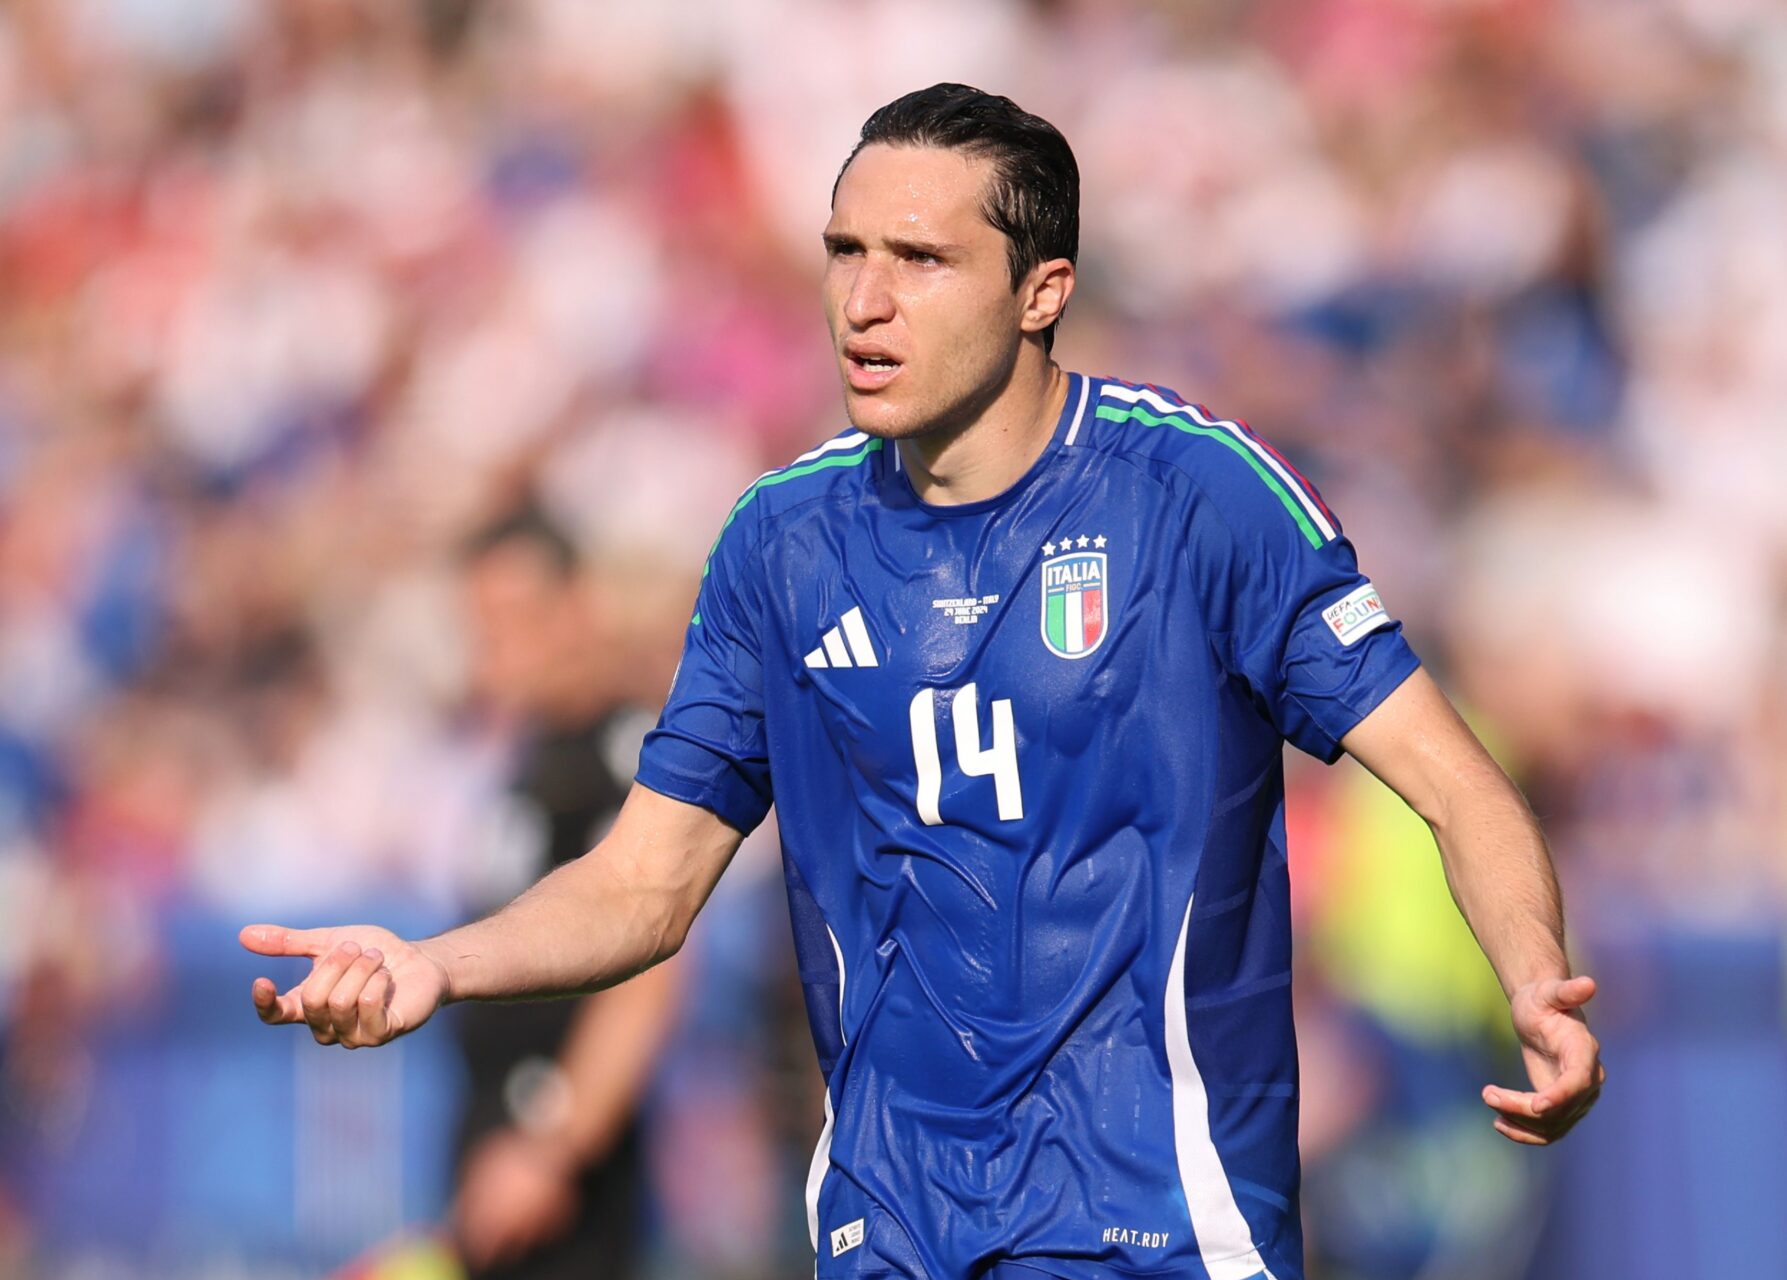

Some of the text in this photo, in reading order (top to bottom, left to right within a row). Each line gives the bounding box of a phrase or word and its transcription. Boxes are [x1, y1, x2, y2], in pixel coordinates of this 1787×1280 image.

[1047, 561, 1101, 587] ITALIA
[982, 595, 999, 605] ITALY
[1326, 600, 1352, 621] UEFA
[954, 615, 978, 624] BERLIN
[909, 682, 1024, 826] 14
[1102, 1227, 1169, 1248] HEAT.RDY
